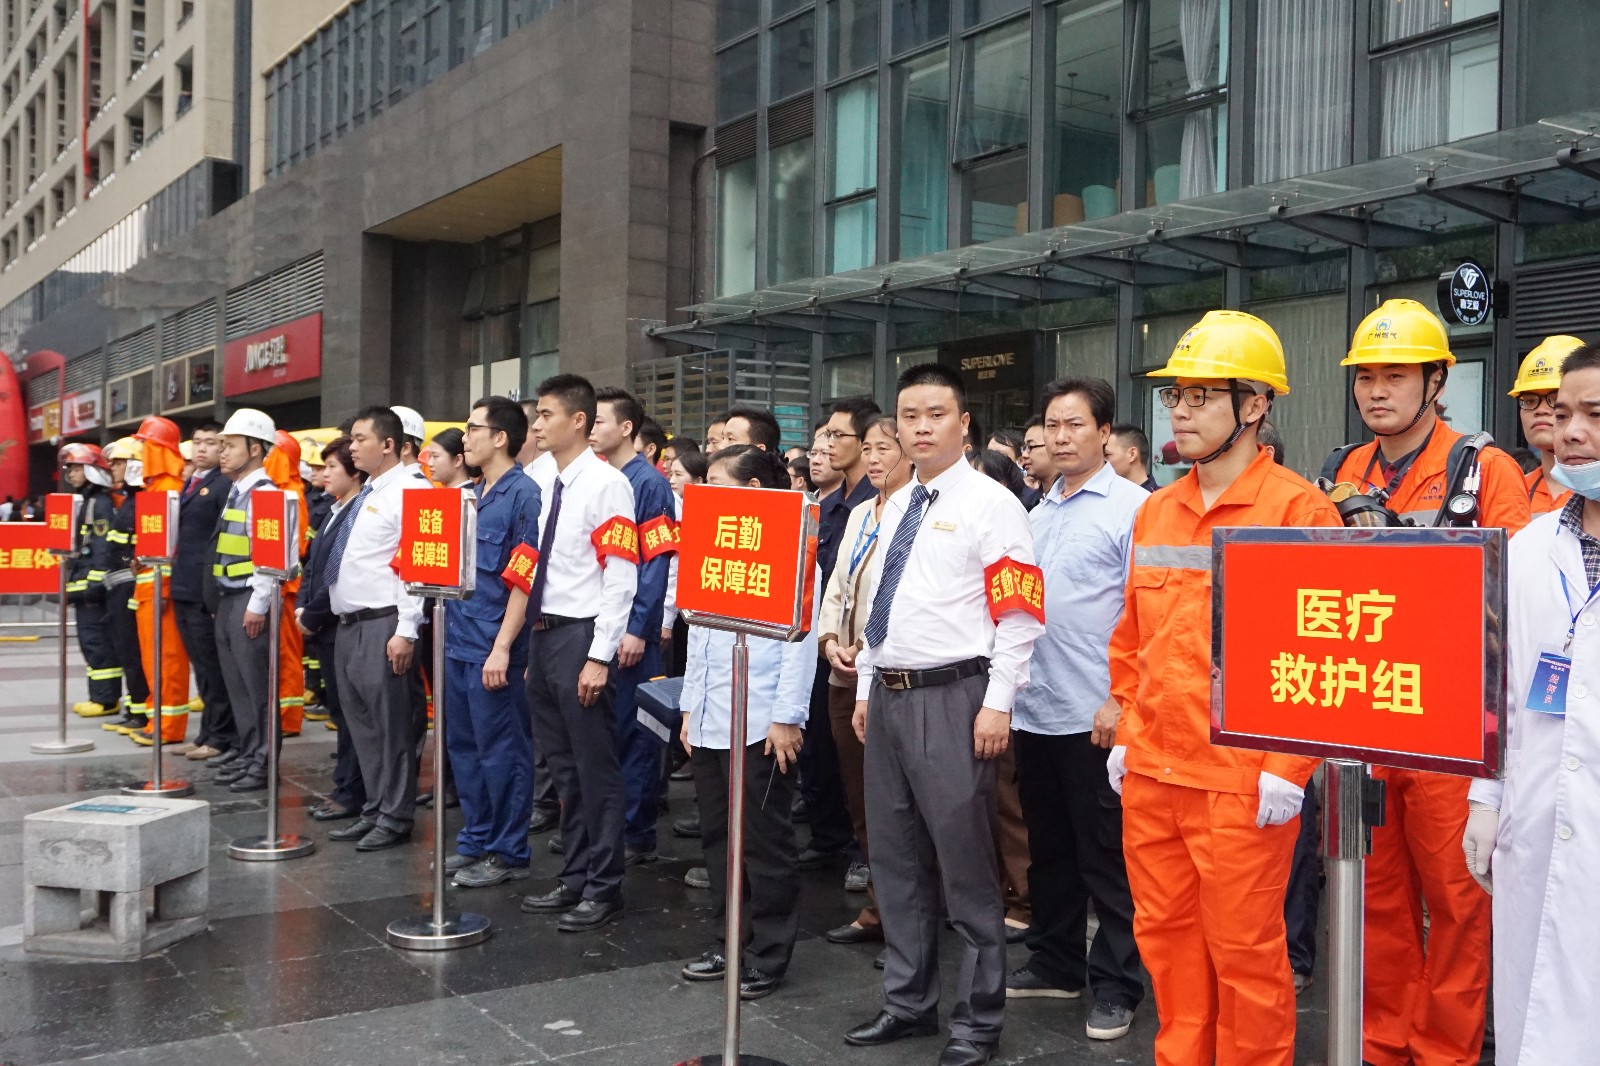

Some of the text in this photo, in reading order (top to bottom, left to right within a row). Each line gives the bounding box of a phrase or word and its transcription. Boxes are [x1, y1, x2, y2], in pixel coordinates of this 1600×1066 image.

[1453, 288, 1486, 300] SUPERLOVE
[961, 353, 1015, 370] SUPERLOVE
[418, 508, 443, 535] 设备
[714, 515, 763, 552] 后勤
[411, 541, 449, 568] 保障组
[700, 556, 771, 598] 保障组
[1297, 588, 1396, 643] 医疗
[1270, 652, 1424, 715] 救护组
